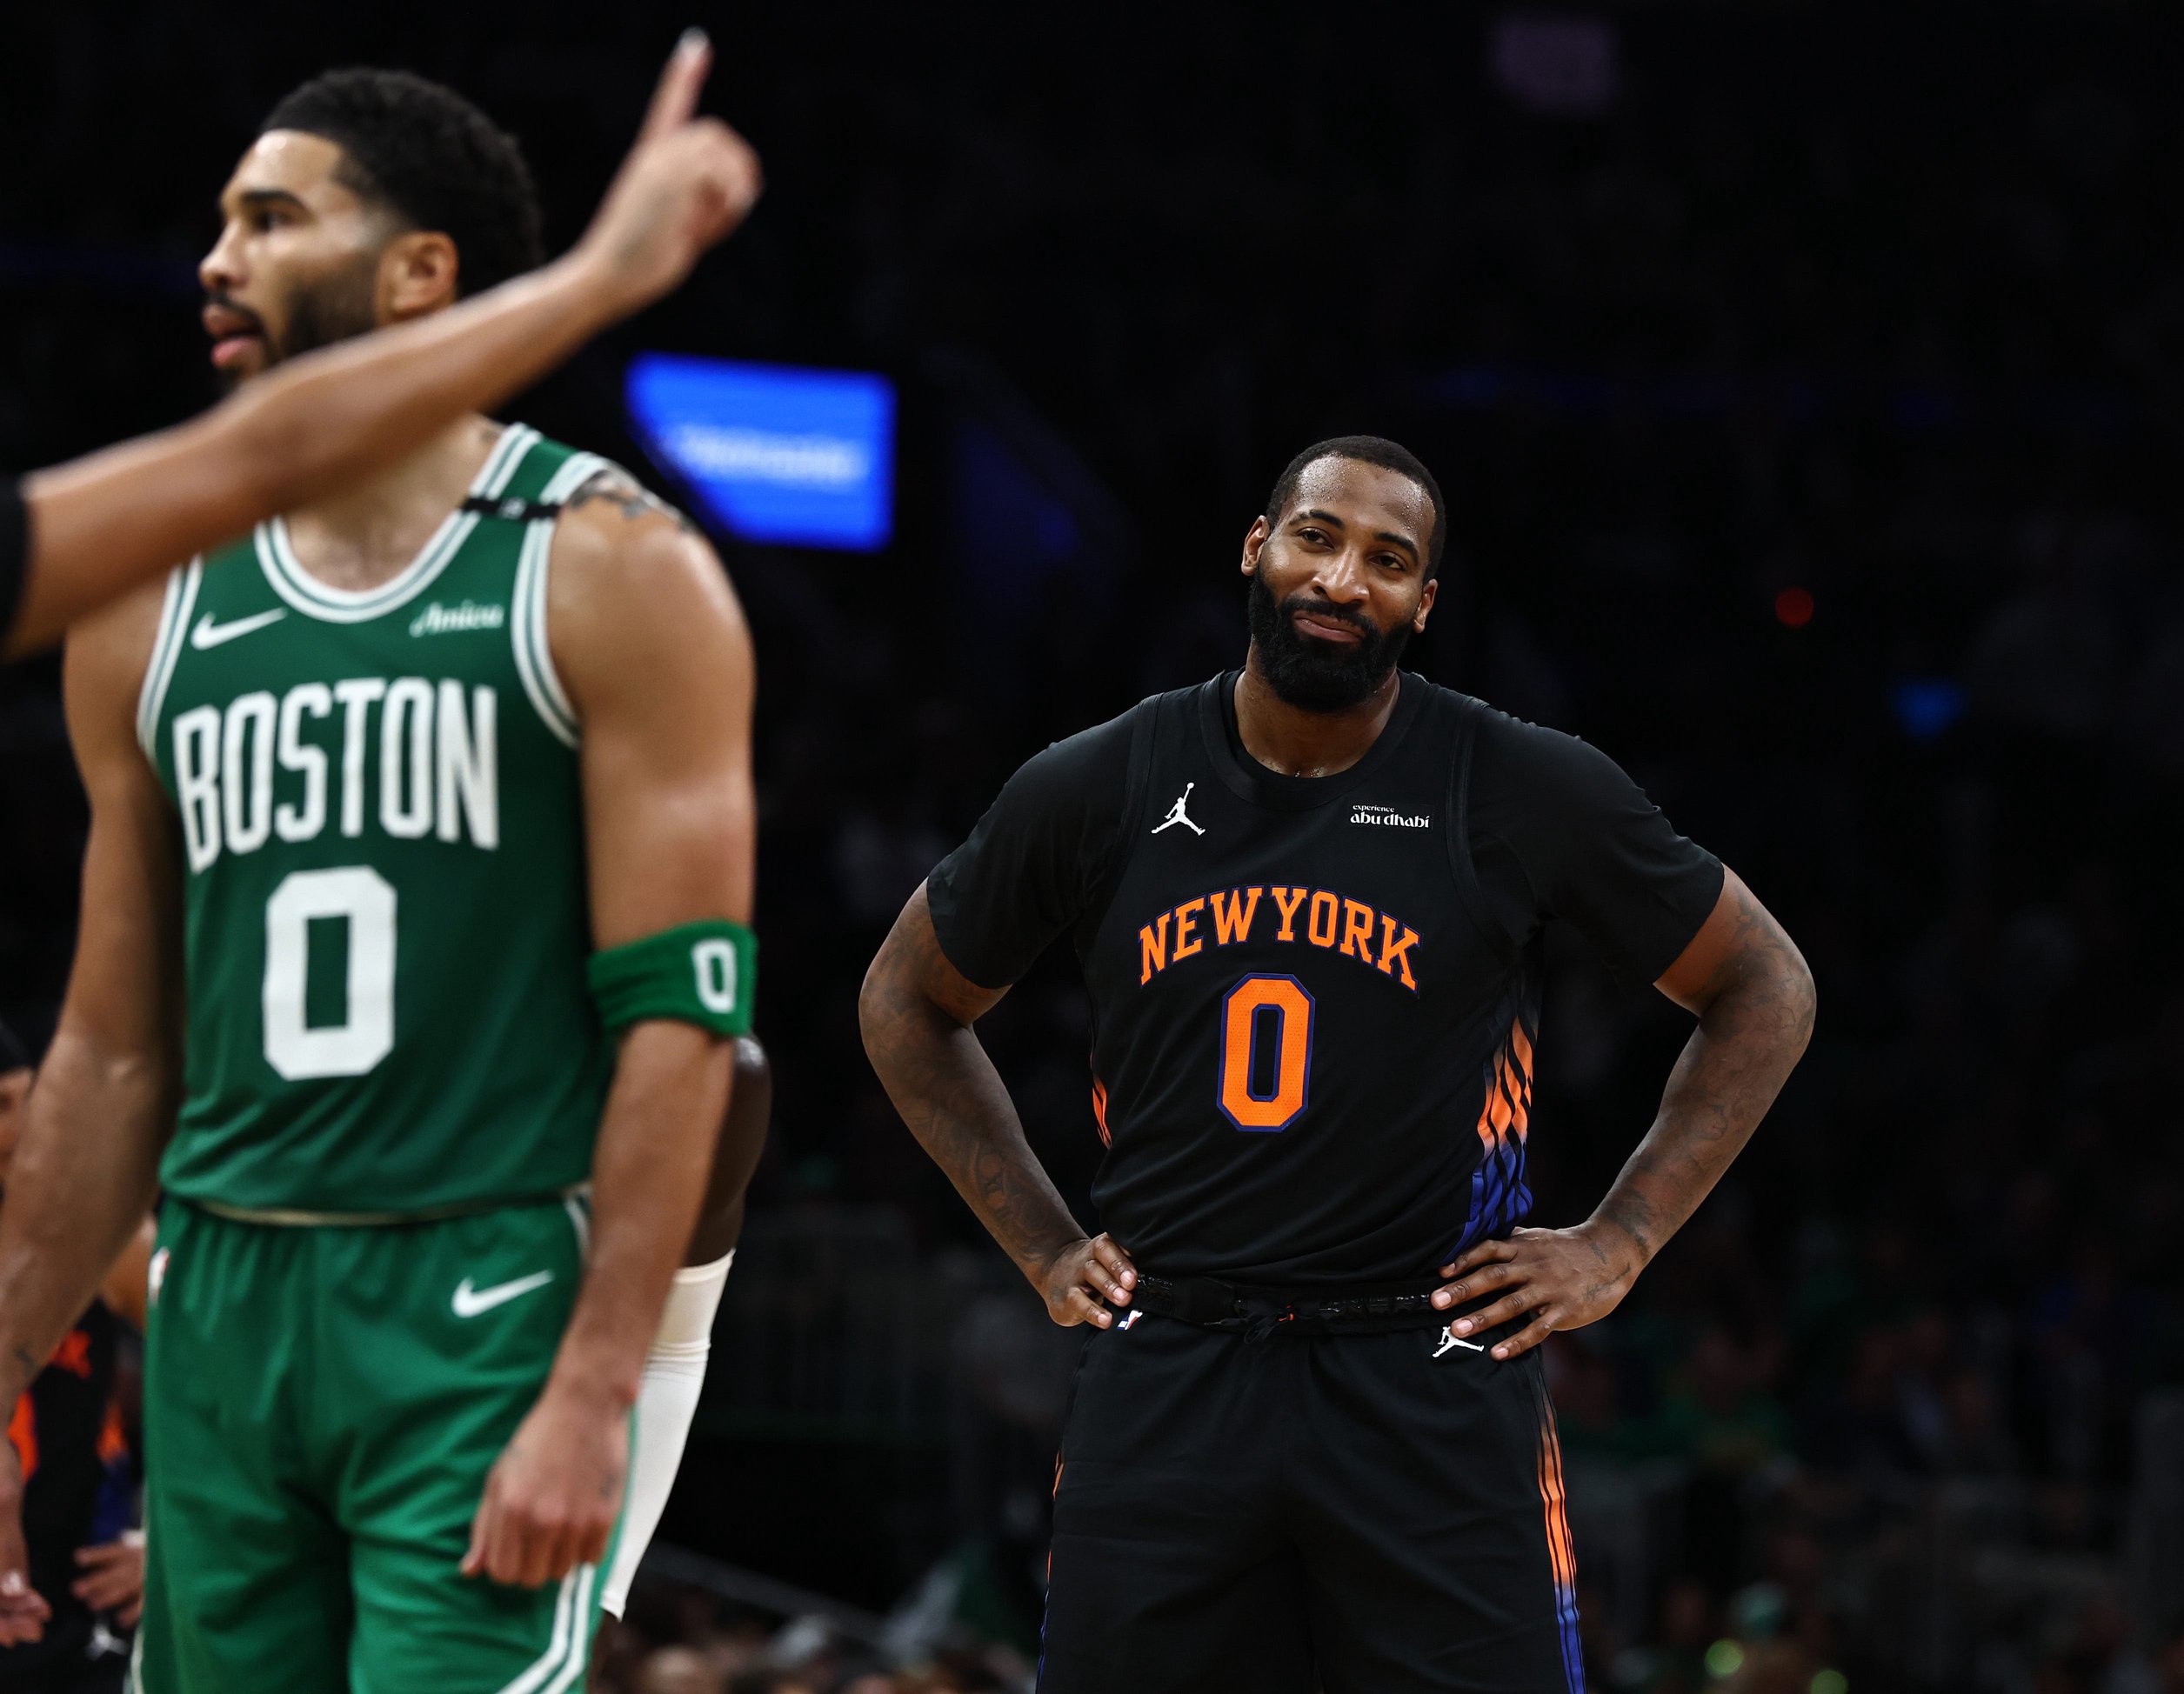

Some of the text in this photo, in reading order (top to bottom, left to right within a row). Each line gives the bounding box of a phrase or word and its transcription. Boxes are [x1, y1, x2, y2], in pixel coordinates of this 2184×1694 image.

[173, 676, 500, 875] BOSTON
[1350, 811, 1381, 825] abu
[1352, 804, 1395, 813] experience
[263, 864, 397, 1080] 0
[690, 937, 738, 1014] 0
[1138, 884, 1422, 995] NEW YORK
[1217, 971, 1315, 1133] 0
